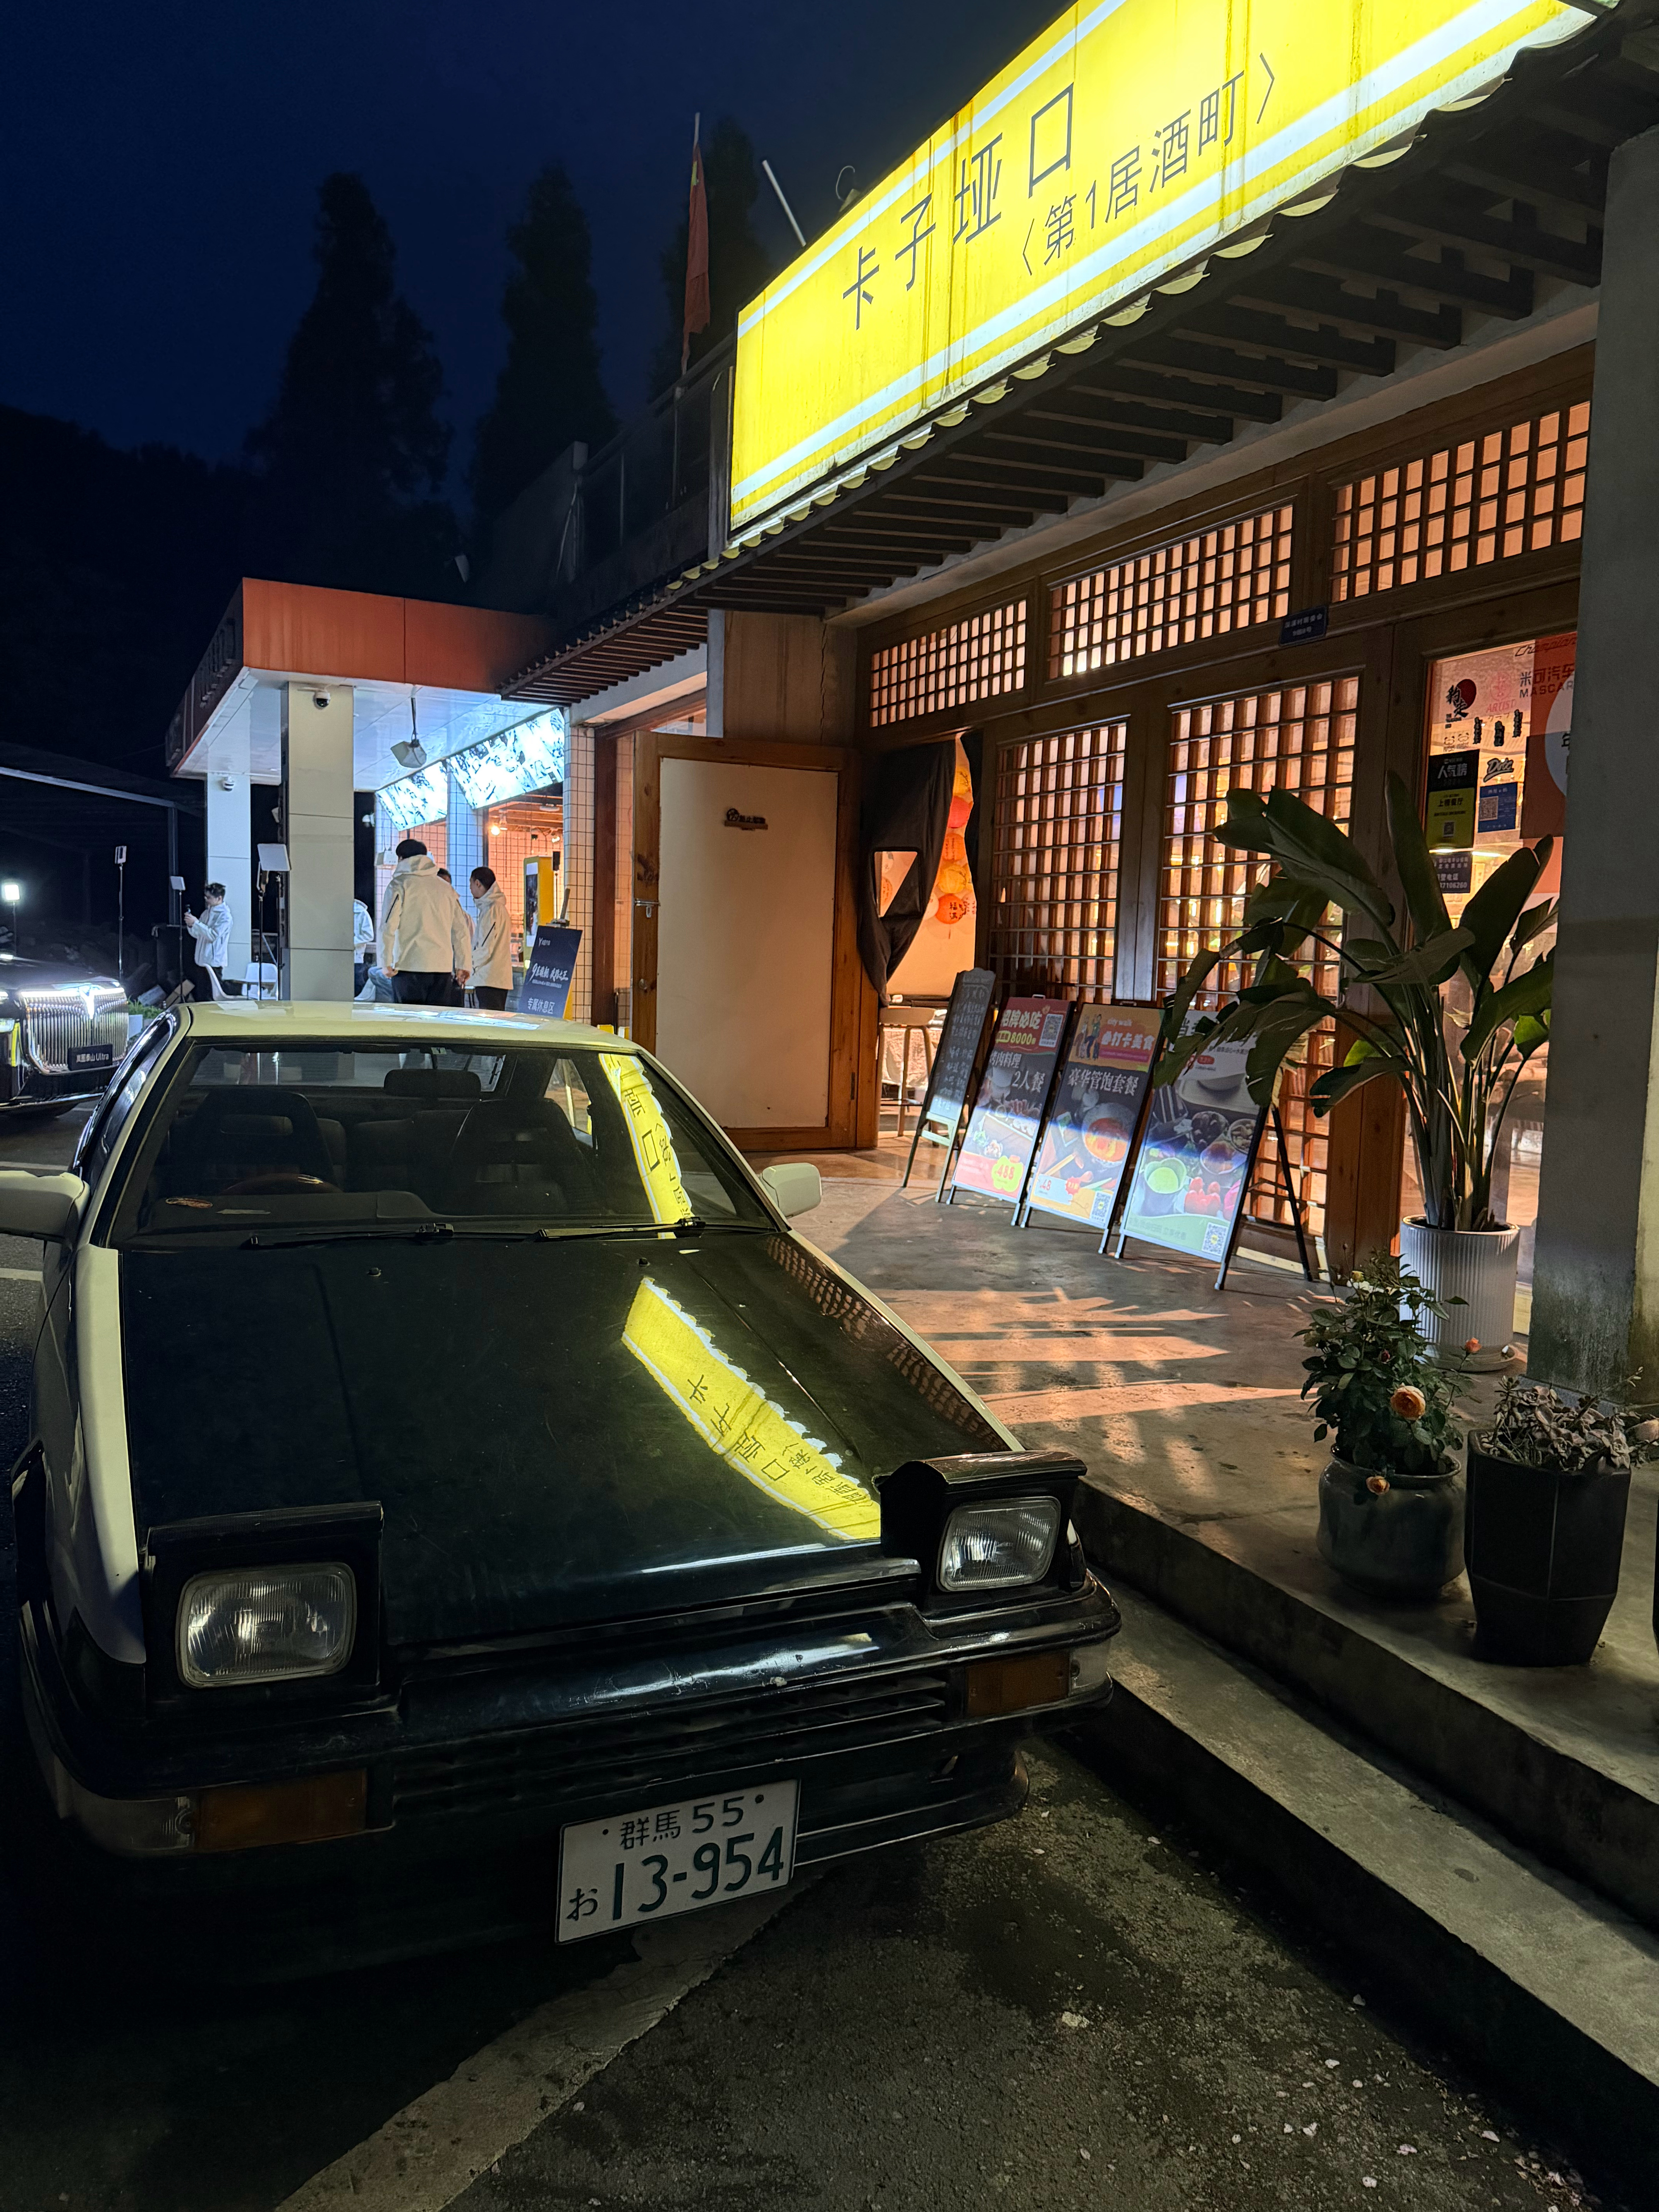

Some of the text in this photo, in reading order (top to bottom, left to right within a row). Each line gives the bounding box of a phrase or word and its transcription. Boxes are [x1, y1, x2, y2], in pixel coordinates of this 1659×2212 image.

[843, 82, 1074, 331] 卡子垭口
[1520, 663, 1575, 687] 米可汽车
[1437, 763, 1467, 779] 人气榜
[527, 997, 555, 1014] 专属休息区
[1000, 1009, 1042, 1029] 招牌必吃
[1011, 1070, 1045, 1093] 2人餐
[1067, 1067, 1139, 1096] 豪华管饱套餐
[620, 1796, 745, 1850] 群馬 55
[566, 1826, 785, 1922] お 13-954
